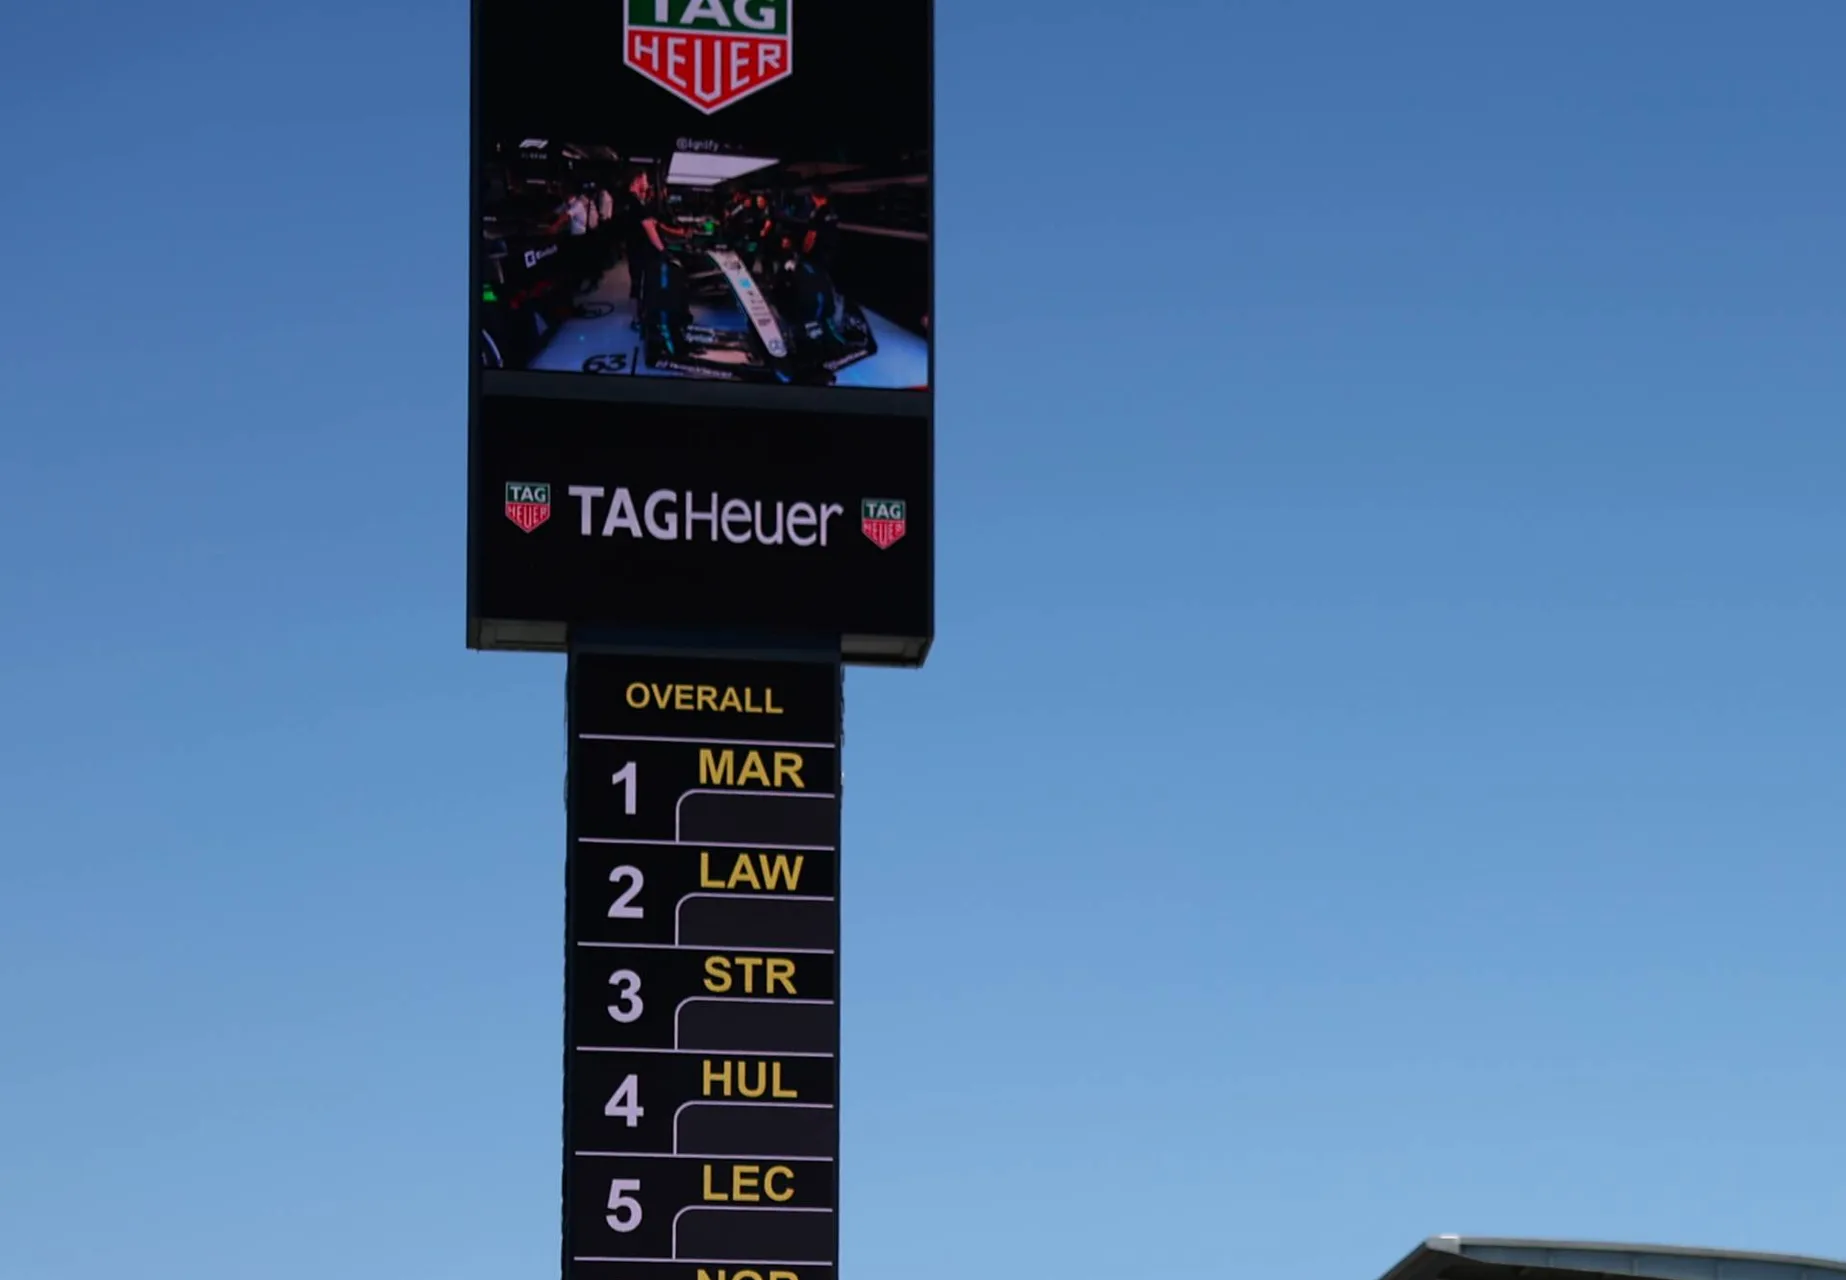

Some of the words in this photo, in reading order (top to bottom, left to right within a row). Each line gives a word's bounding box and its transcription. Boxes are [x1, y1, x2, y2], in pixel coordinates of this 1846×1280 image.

[651, 0, 776, 29] TAG
[634, 35, 781, 101] HEUER
[510, 484, 545, 502] TAG
[866, 501, 902, 520] TAG
[507, 506, 550, 531] HEUER
[863, 523, 905, 548] HEUER
[626, 683, 783, 713] OVERALL
[613, 762, 636, 814] 1
[700, 749, 804, 787] MAR
[608, 865, 643, 918] 2
[701, 852, 804, 890] LAW
[608, 970, 643, 1022] 3
[704, 956, 796, 994] STR
[605, 1075, 644, 1127] 4
[704, 1060, 797, 1097] HUL
[606, 1179, 642, 1232] 5
[704, 1165, 794, 1201] LEC
